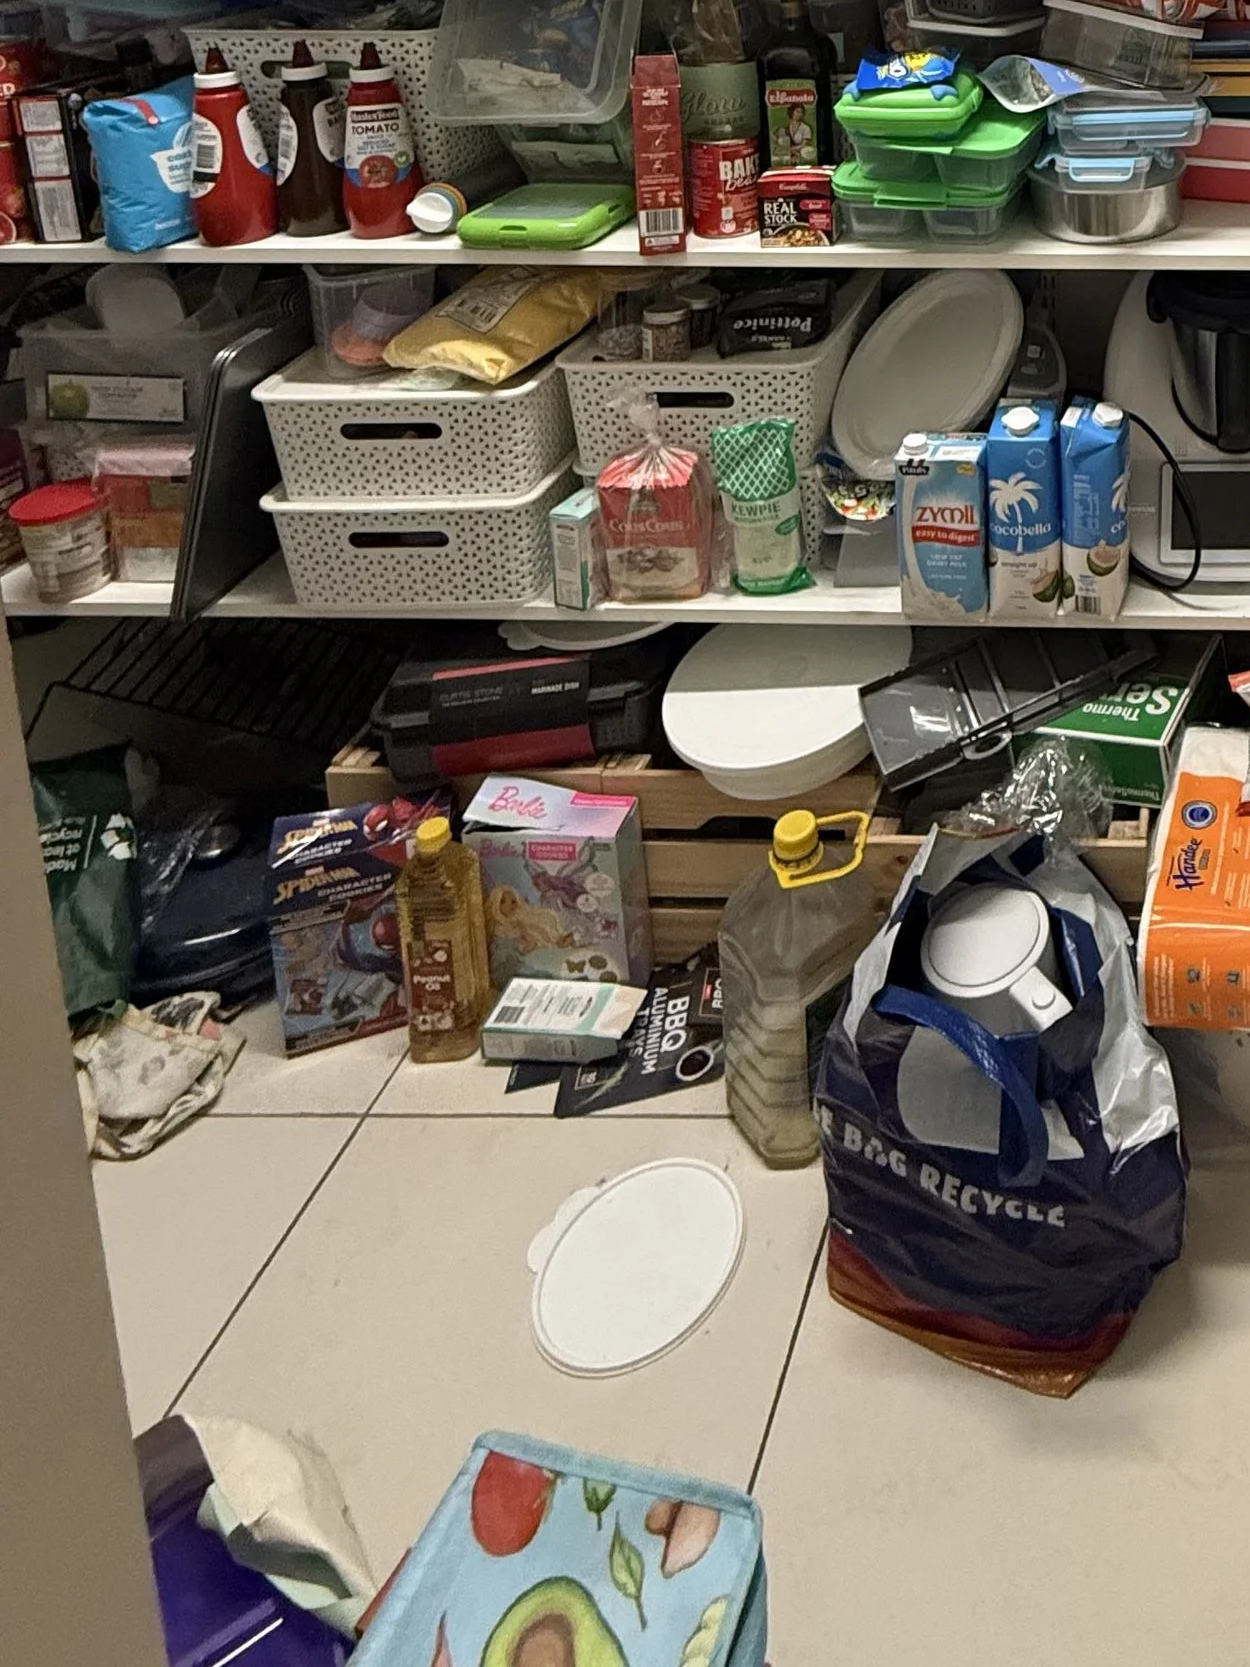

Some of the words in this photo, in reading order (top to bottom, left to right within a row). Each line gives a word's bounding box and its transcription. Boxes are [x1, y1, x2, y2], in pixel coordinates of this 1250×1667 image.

[681, 90, 749, 125] Glow
[351, 122, 400, 134] TOMATO
[764, 203, 797, 215] REAL
[764, 214, 798, 224] STOCK
[733, 315, 812, 333] Pettinice
[731, 500, 782, 516] KEWPIE
[915, 529, 936, 540] easy
[937, 530, 948, 539] to
[948, 531, 976, 544] digest
[990, 523, 1052, 536] cocobella
[926, 560, 946, 568] DAIRY
[440, 689, 471, 702] CURTIS
[474, 687, 503, 699] STONE
[531, 683, 563, 695] MARINADE
[563, 681, 580, 691] DISH
[1082, 702, 1141, 722] Thermo
[487, 786, 549, 820] Barbie
[65, 843, 81, 856] at
[294, 847, 342, 865] COOKIES
[479, 838, 522, 859] Barbie
[530, 844, 574, 852] CHARACTER
[535, 851, 569, 859] COOKIES
[1172, 837, 1205, 891] Handee
[317, 872, 392, 898] CHARACTER
[328, 883, 384, 902] COOKIES
[413, 974, 451, 985] Peanut
[425, 982, 441, 992] Oil
[628, 1006, 652, 1058] TRAYS
[640, 986, 669, 1075] ALUMINIUM
[661, 995, 690, 1053] BBQ
[843, 1121, 908, 1178] BAG
[919, 1162, 1066, 1229] RECYCLE
